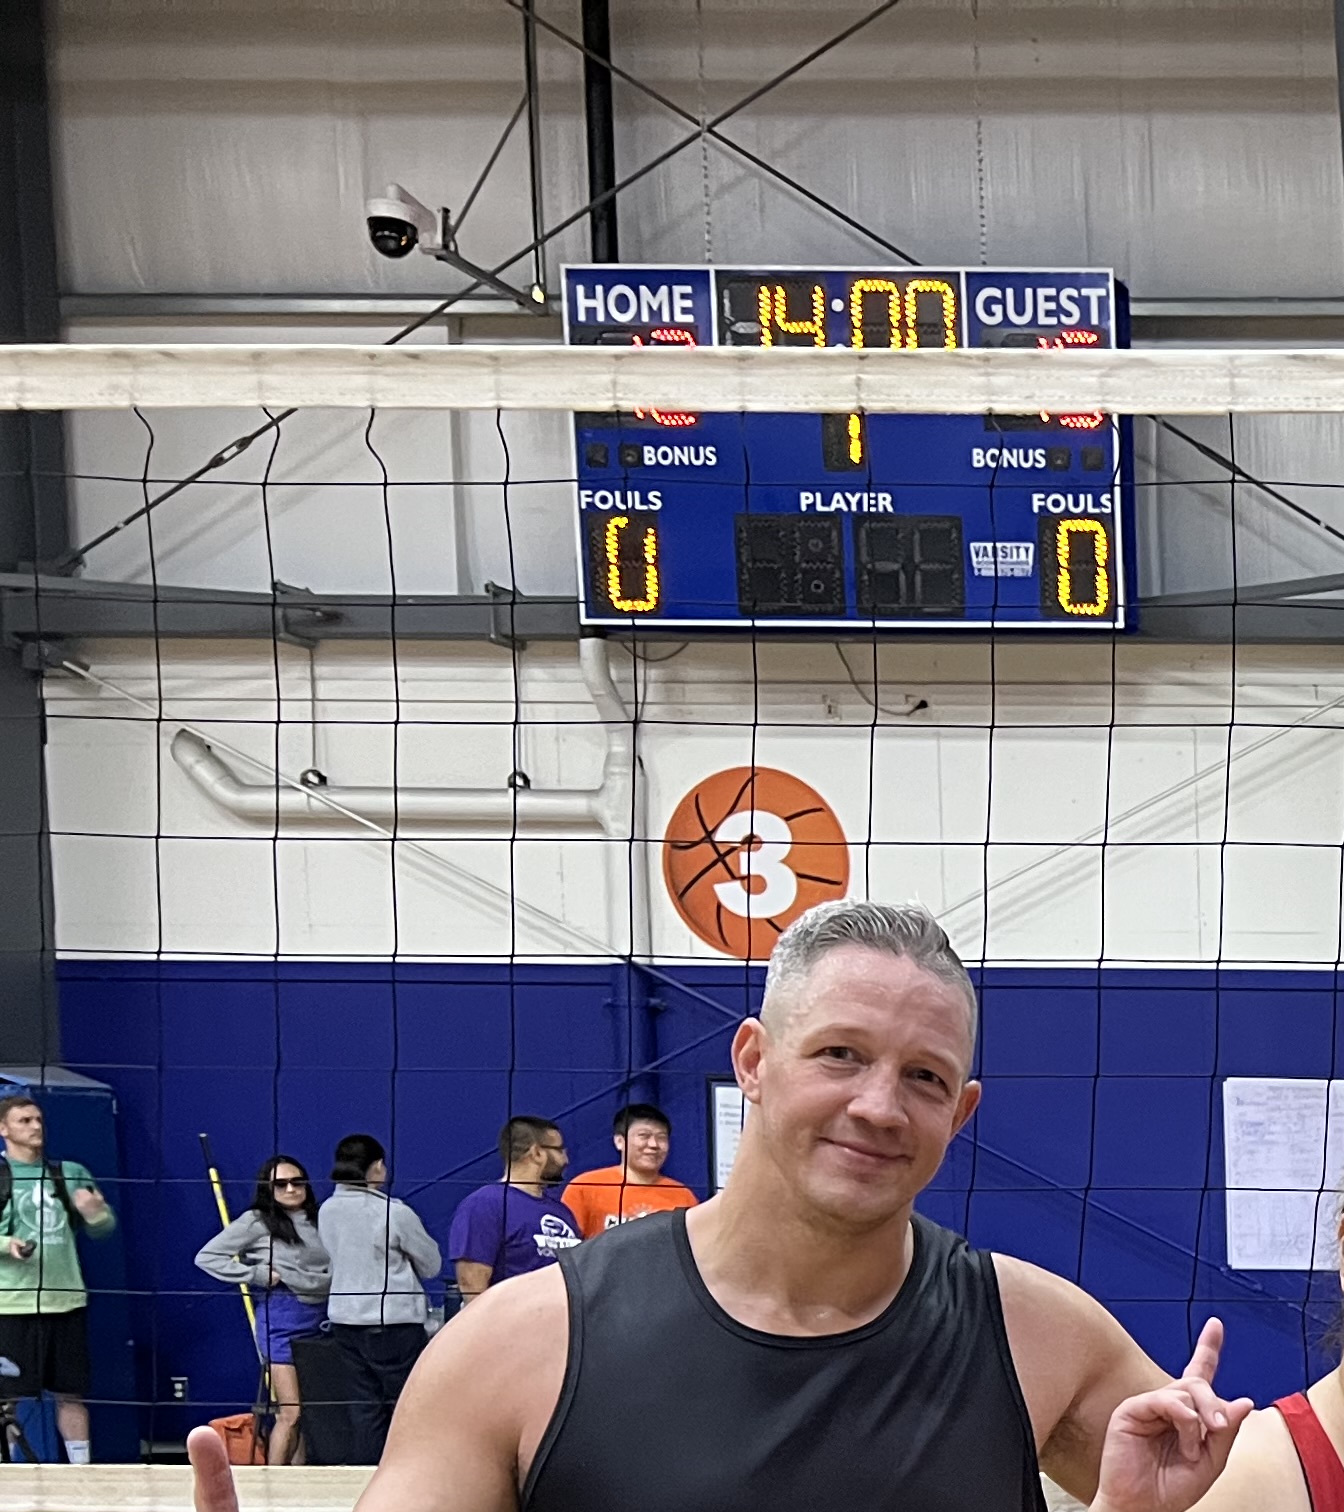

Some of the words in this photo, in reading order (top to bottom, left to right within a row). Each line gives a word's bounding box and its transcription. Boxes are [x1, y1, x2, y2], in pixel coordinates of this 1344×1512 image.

[576, 284, 695, 323] HOME
[974, 286, 1107, 326] GUEST
[643, 445, 717, 467] BONUS
[971, 447, 1046, 470] BONUS
[580, 490, 662, 512] FOULS
[799, 491, 893, 513] PLAYER
[1031, 492, 1112, 514] FOULS
[973, 545, 1031, 559] VASITY
[1056, 517, 1109, 615] 0
[712, 809, 798, 919] 3
